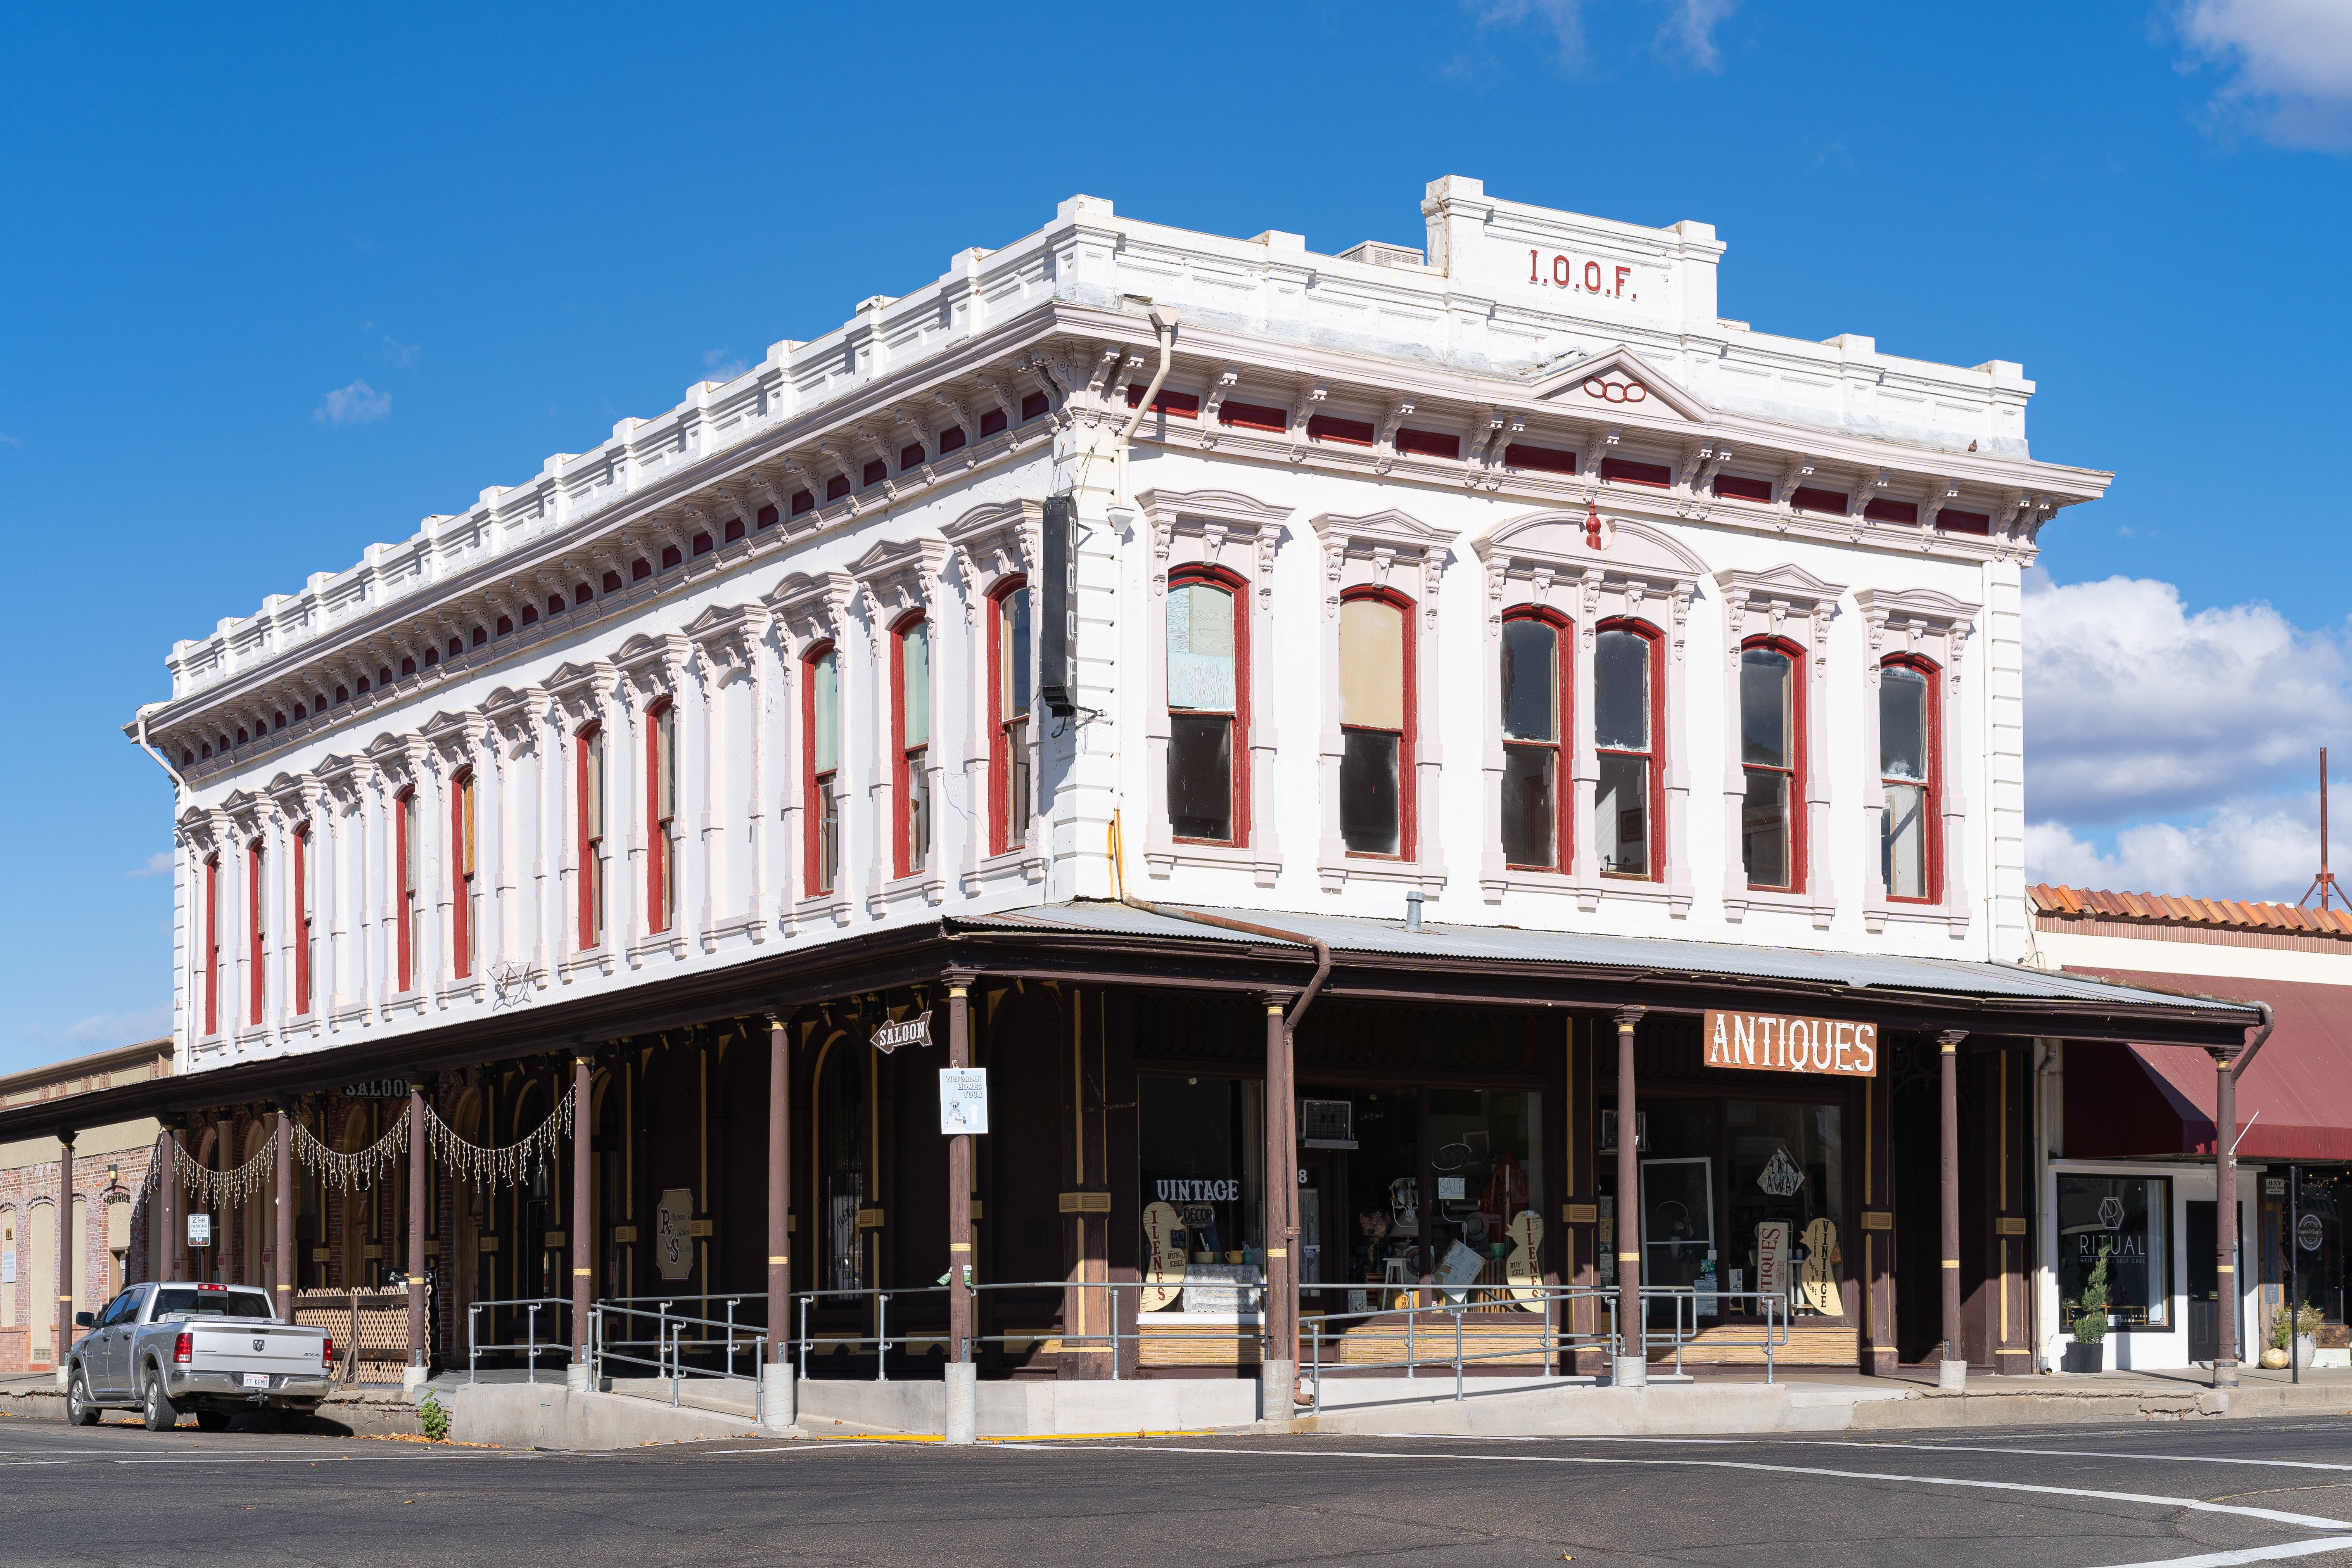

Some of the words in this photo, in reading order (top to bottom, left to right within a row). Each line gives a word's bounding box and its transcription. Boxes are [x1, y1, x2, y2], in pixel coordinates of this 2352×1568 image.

[1530, 249, 1637, 299] I.O.O.F.
[879, 1021, 925, 1046] SALOON
[1709, 1013, 1874, 1073] ANTIQUES
[944, 1075, 982, 1083] VICTORIAN
[1431, 1150, 1471, 1165] OPEN
[1156, 1179, 1239, 1201] VINTAGE
[1439, 1179, 1464, 1194] SALE
[1767, 1174, 1799, 1195] AWAY
[672, 1210, 692, 1222] Round-U
[1183, 1207, 1213, 1222] DECOR
[677, 1226, 691, 1237] Saloo
[2080, 1235, 2145, 1255] RITUAL
[1150, 1210, 1165, 1301] ILENES
[1167, 1251, 1180, 1260] BUY
[1169, 1260, 1184, 1268] SELL
[1820, 1220, 1830, 1308] VINTAGE
[2266, 1215, 2276, 1301] WELCOME
[1808, 1259, 1819, 1277] GIFTS
[1806, 1281, 1817, 1295] MORE
